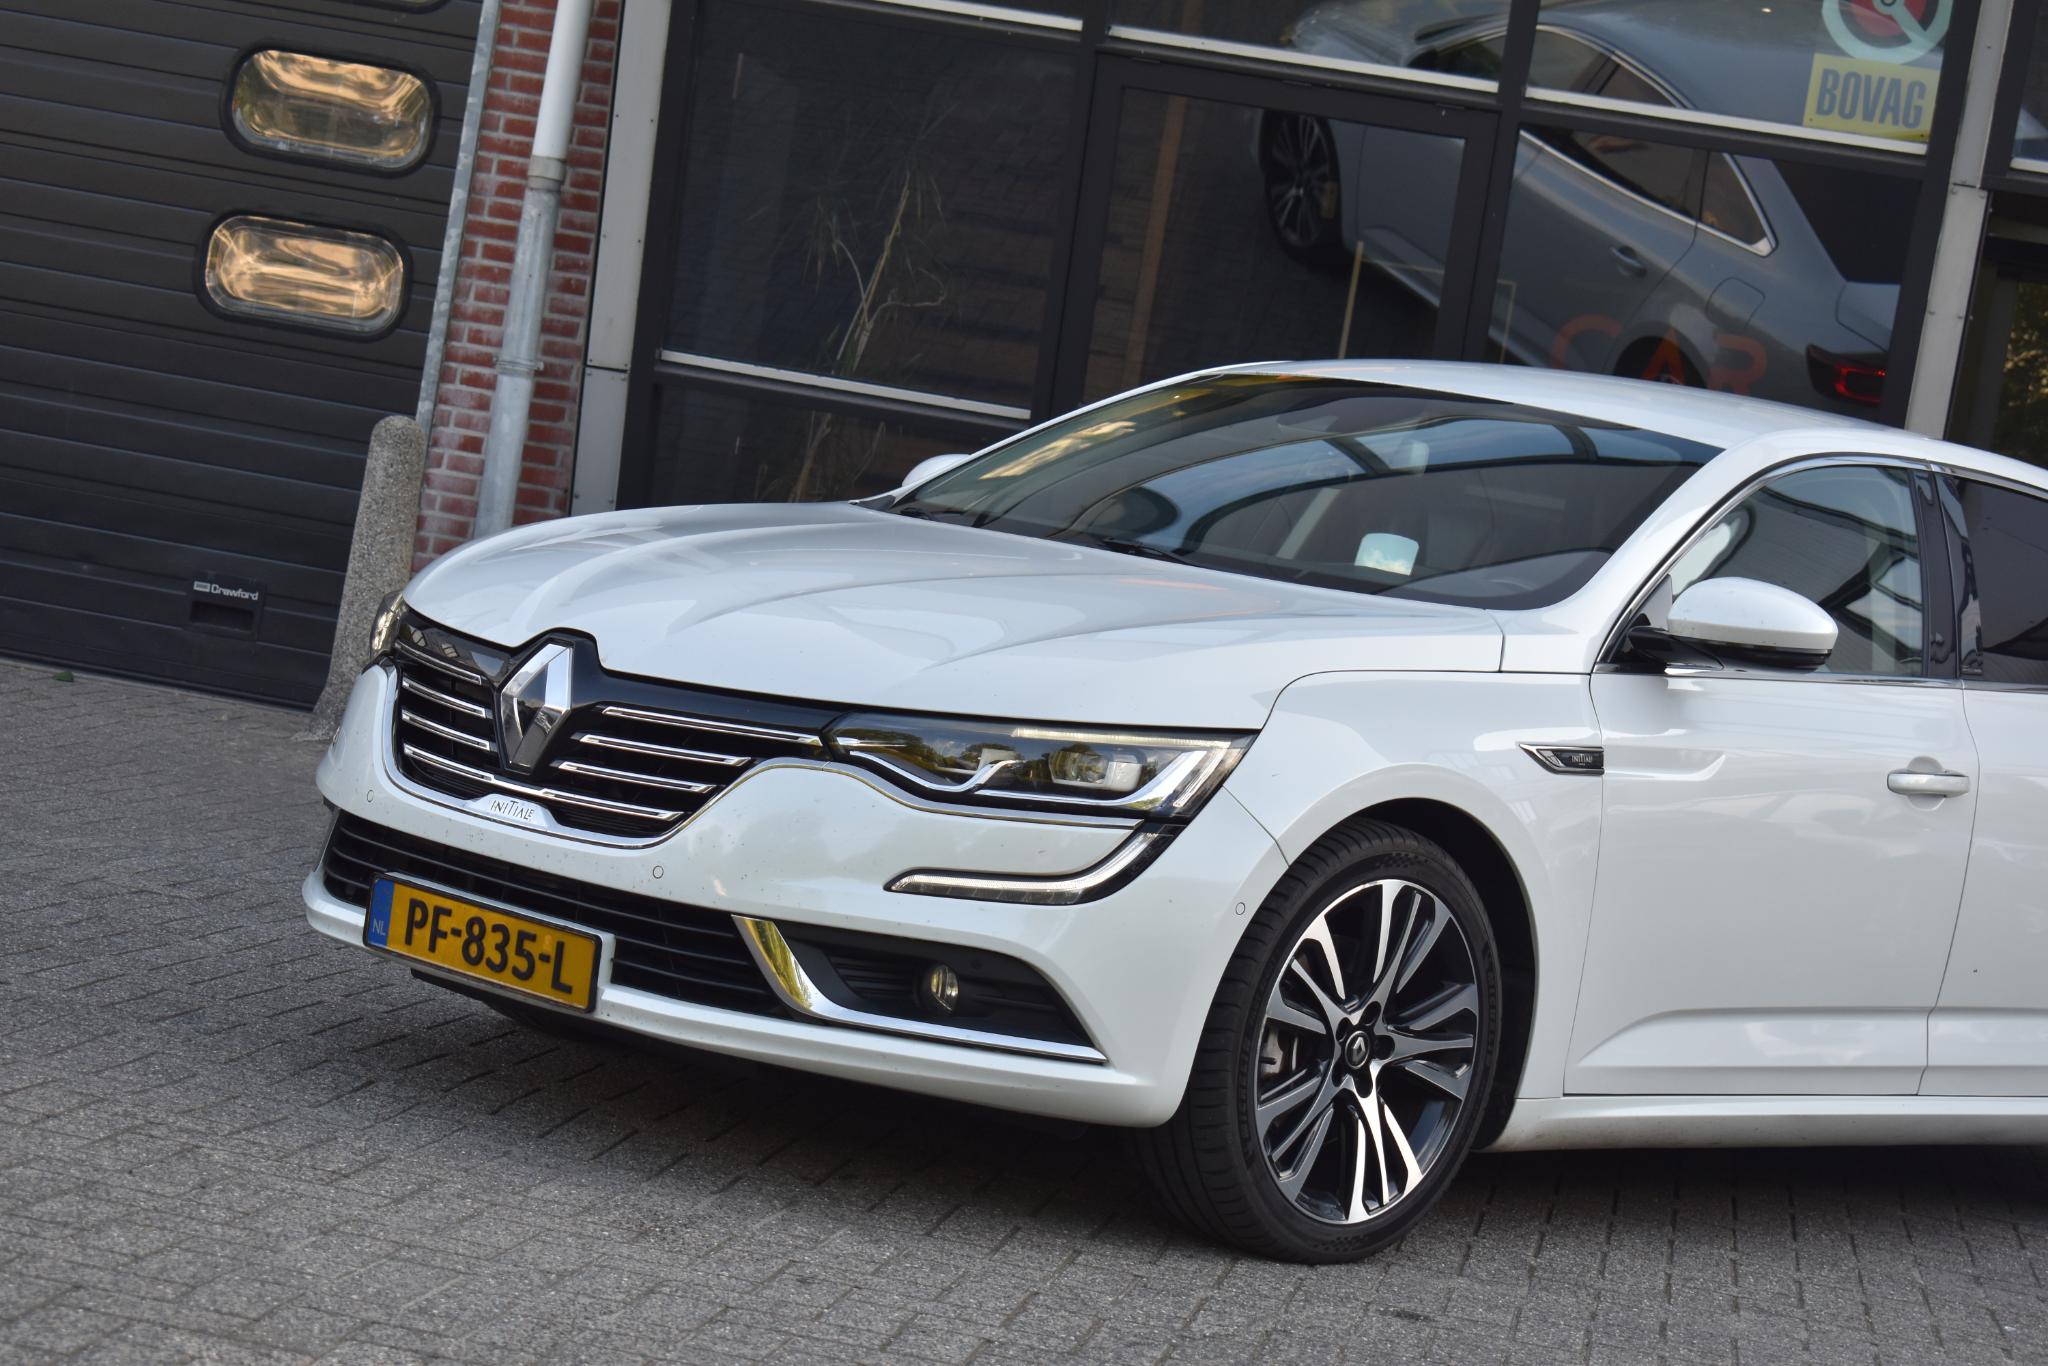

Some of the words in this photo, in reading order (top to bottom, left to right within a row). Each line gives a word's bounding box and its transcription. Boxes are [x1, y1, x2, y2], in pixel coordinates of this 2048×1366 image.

[1815, 67, 1927, 129] BOVAG
[211, 583, 259, 600] Crawford
[490, 800, 535, 820] INITIALE
[372, 917, 386, 937] NL
[404, 897, 573, 994] PF-835-L
